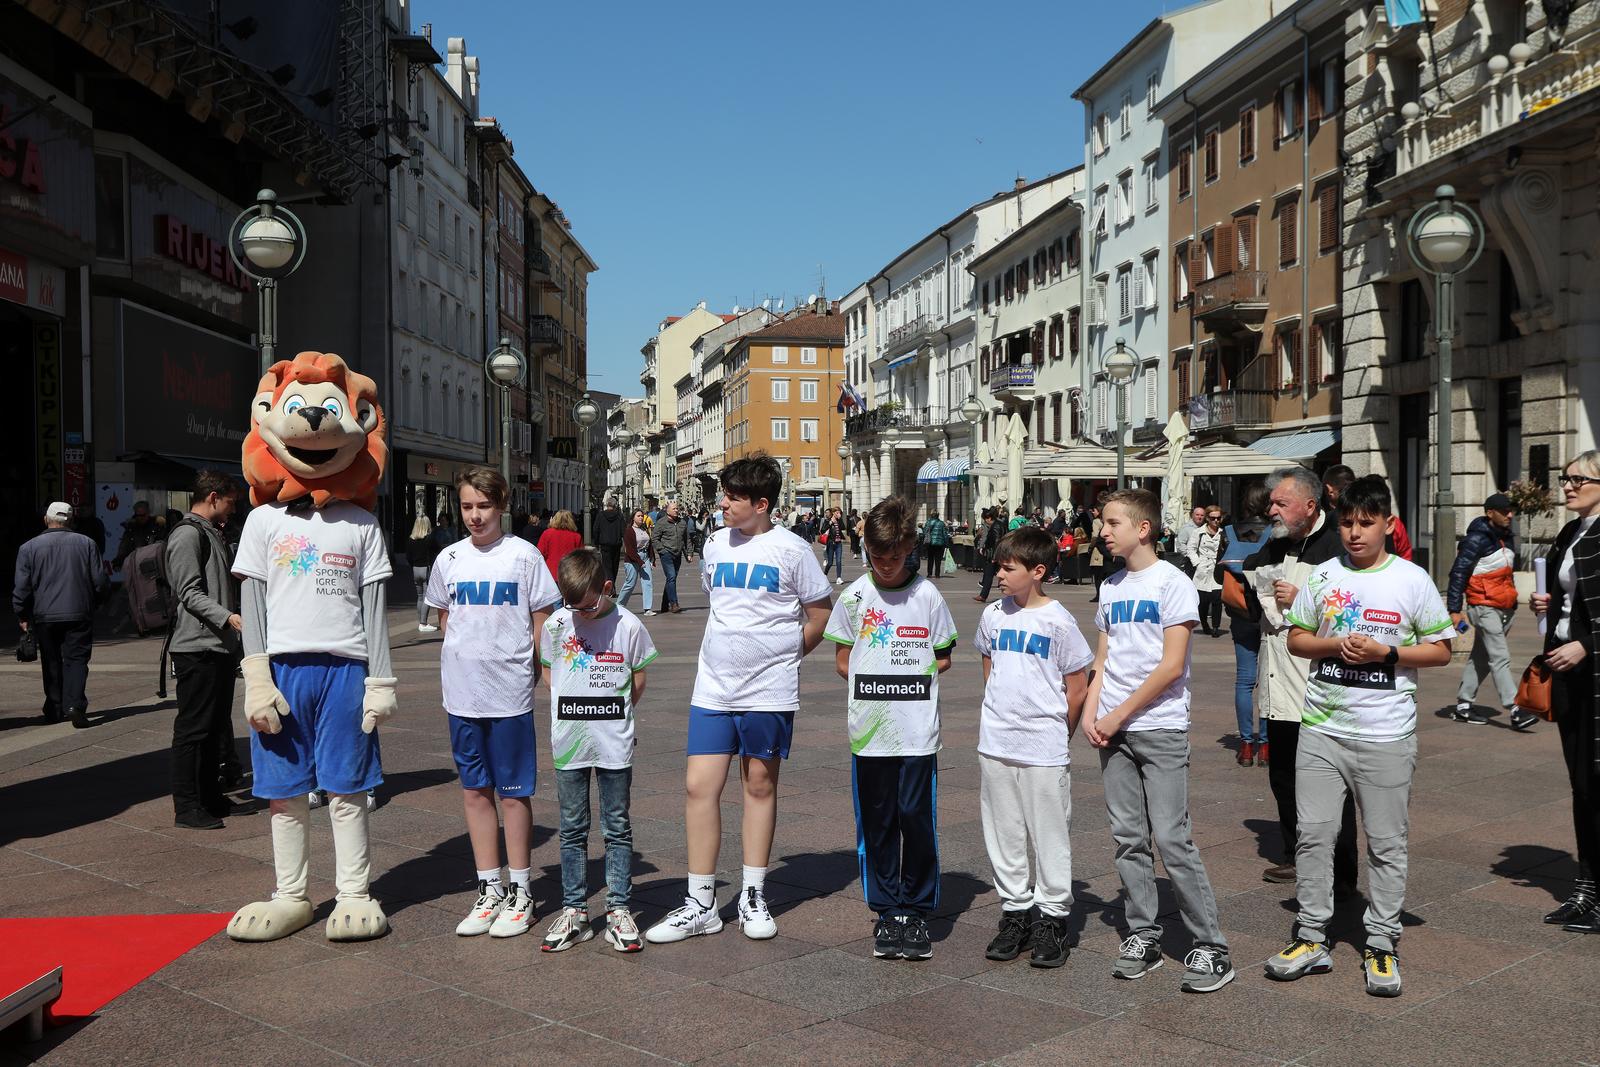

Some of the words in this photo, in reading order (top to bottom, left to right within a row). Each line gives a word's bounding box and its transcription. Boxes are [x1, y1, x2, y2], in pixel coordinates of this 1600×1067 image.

[165, 214, 254, 292] RIJEKA
[39, 328, 57, 415] OTKUP
[41, 424, 58, 496] ZLAT
[325, 555, 354, 566] plazma
[315, 578, 337, 586] IGRE
[1366, 611, 1398, 621] plazma
[899, 628, 925, 636] plazma
[1356, 623, 1398, 636] SPORTSKE
[891, 640, 929, 649] SPORTSKE
[891, 649, 908, 657] IGRE
[890, 658, 920, 666] MLADIH
[589, 665, 624, 673] SPORTSKE
[1321, 662, 1388, 683] telemach
[859, 681, 925, 694] telemach
[561, 702, 620, 715] telemach
